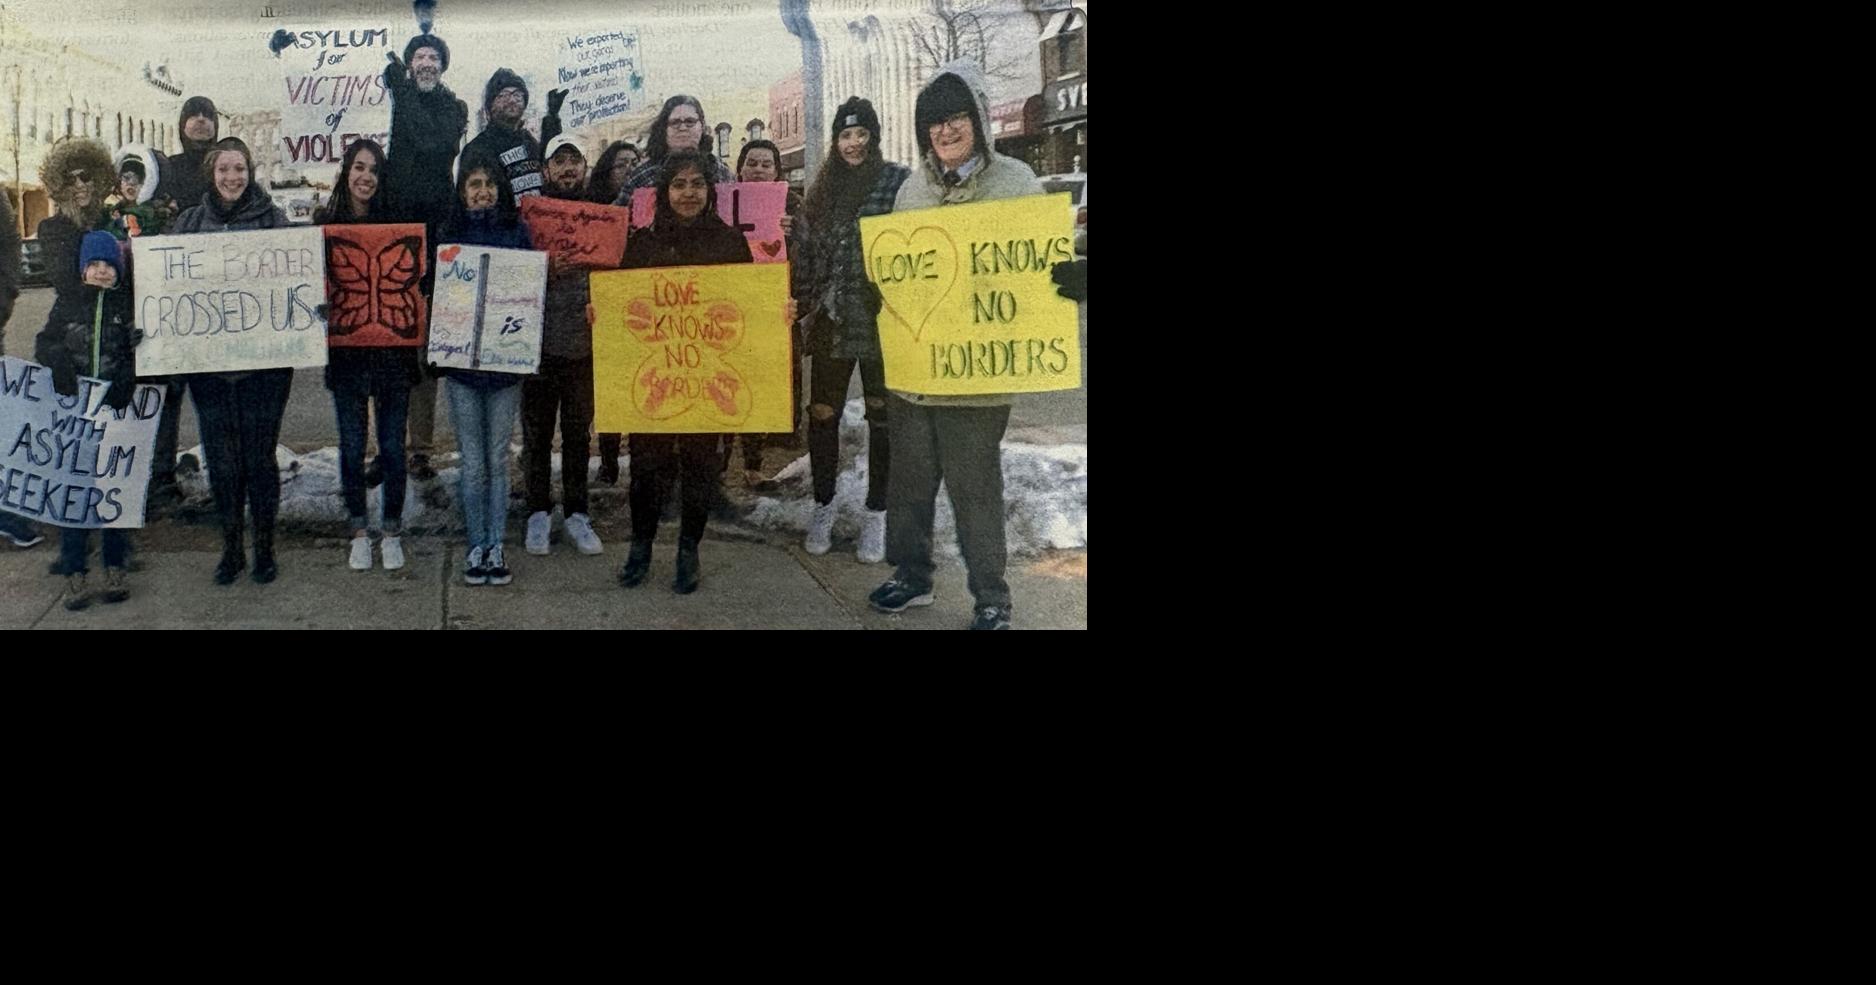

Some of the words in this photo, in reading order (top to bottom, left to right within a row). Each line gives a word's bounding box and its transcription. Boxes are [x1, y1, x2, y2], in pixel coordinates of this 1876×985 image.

[567, 36, 583, 49] We
[312, 50, 347, 71] for
[285, 74, 386, 106] VICTIMS
[324, 106, 348, 133] of
[569, 98, 594, 116] They
[282, 132, 388, 164] VIOLE
[149, 246, 205, 281] THE
[442, 261, 477, 282] No
[875, 249, 939, 284] LOVE
[970, 236, 1073, 275] KNOWS
[653, 280, 700, 308] LOVE
[973, 289, 1017, 325] NO
[142, 289, 262, 339] CROSSED
[270, 283, 316, 331] US
[500, 316, 526, 335] is
[652, 314, 724, 342] KNOWS
[664, 343, 701, 374] NO
[931, 337, 1069, 379] BORDERS
[1, 360, 41, 402] WE
[52, 410, 107, 441] WITH
[8, 423, 136, 478] ASYLUM
